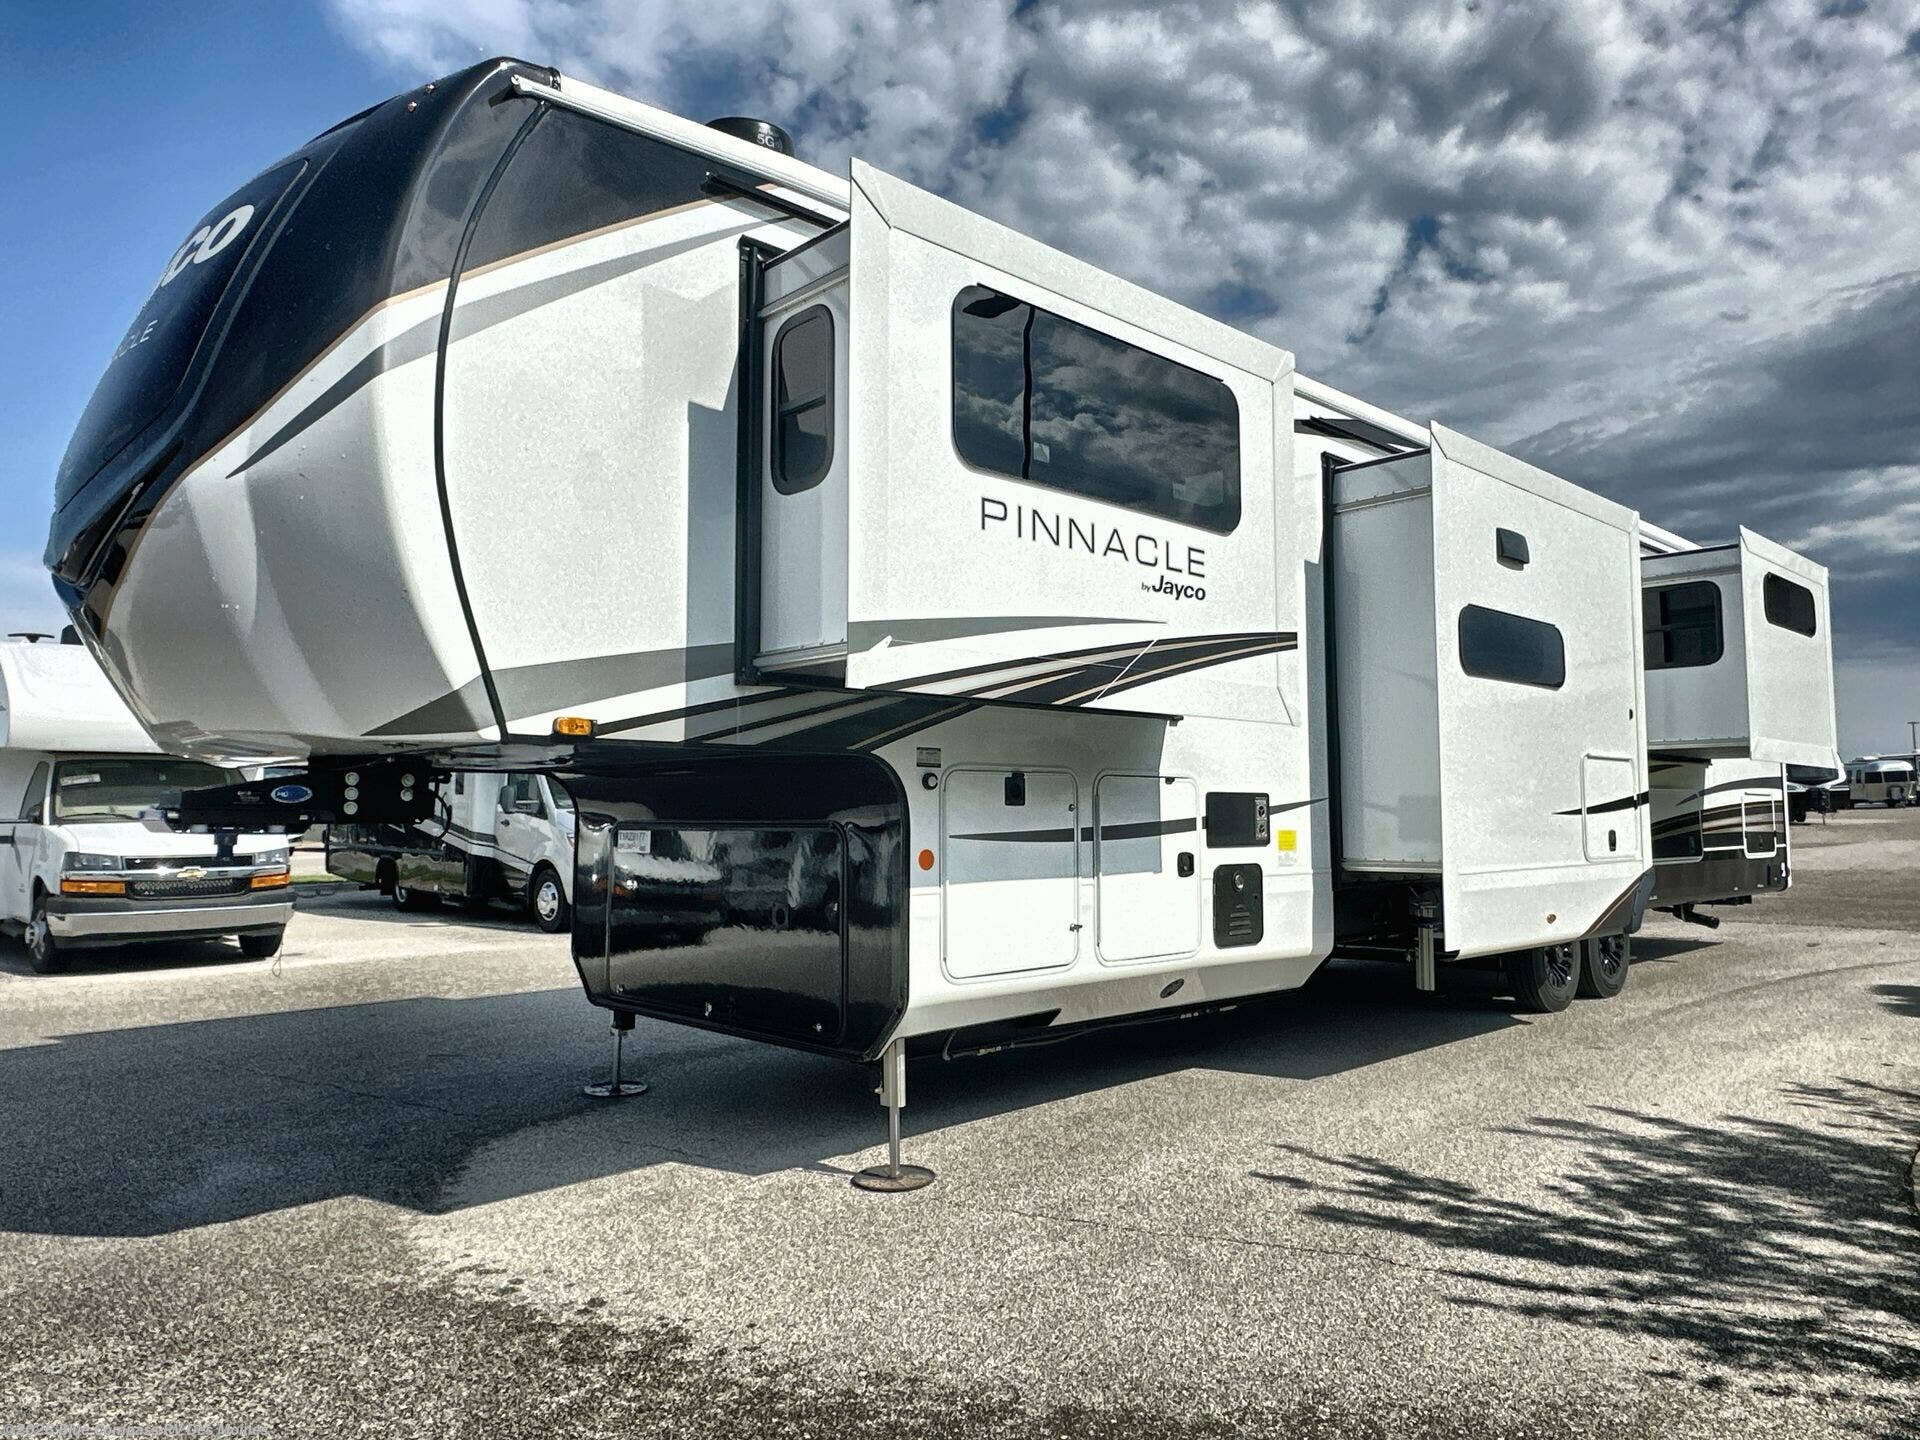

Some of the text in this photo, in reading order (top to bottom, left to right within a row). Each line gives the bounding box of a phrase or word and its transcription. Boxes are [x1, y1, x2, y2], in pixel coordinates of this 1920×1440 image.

[757, 133, 775, 148] 5G
[981, 496, 1206, 579] PINNACLE
[1141, 574, 1206, 601] by Jayco
